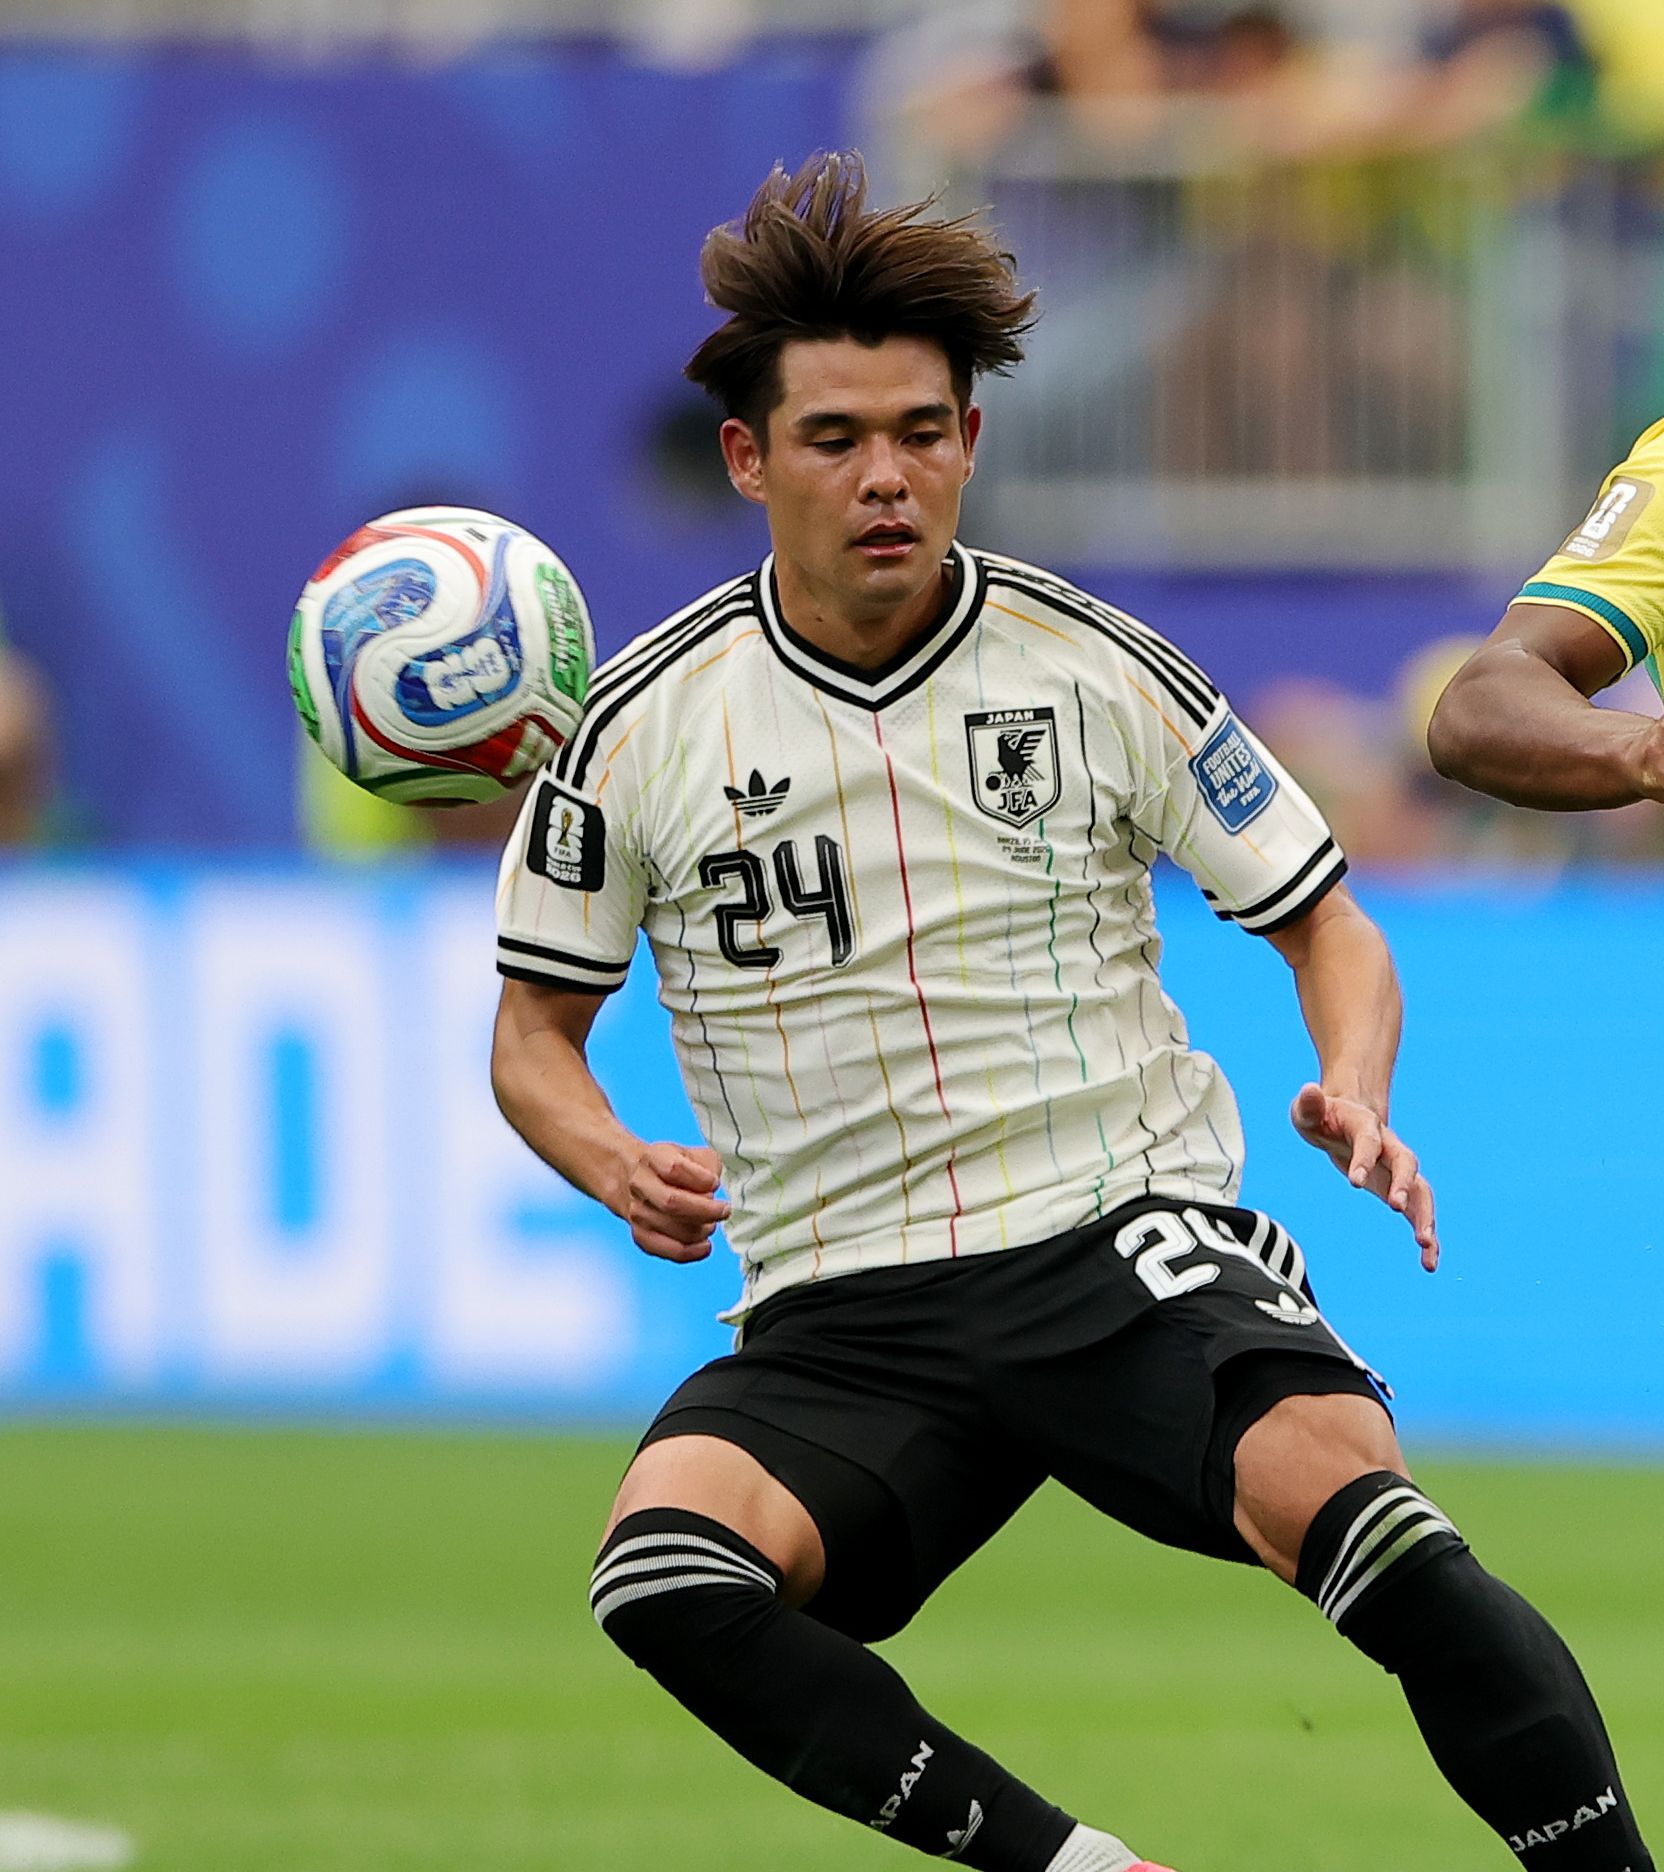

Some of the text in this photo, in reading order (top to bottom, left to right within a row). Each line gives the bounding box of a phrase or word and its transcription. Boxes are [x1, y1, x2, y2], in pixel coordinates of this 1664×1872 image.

[985, 710, 1034, 725] JAPAN
[1202, 730, 1241, 776] FOOTBALL
[1209, 742, 1251, 790] UNITES
[997, 790, 1038, 810] JFA
[1216, 787, 1238, 808] the
[554, 846, 572, 859] FIFA
[698, 834, 856, 972] 24
[1509, 1785, 1618, 1852] JAPAN
